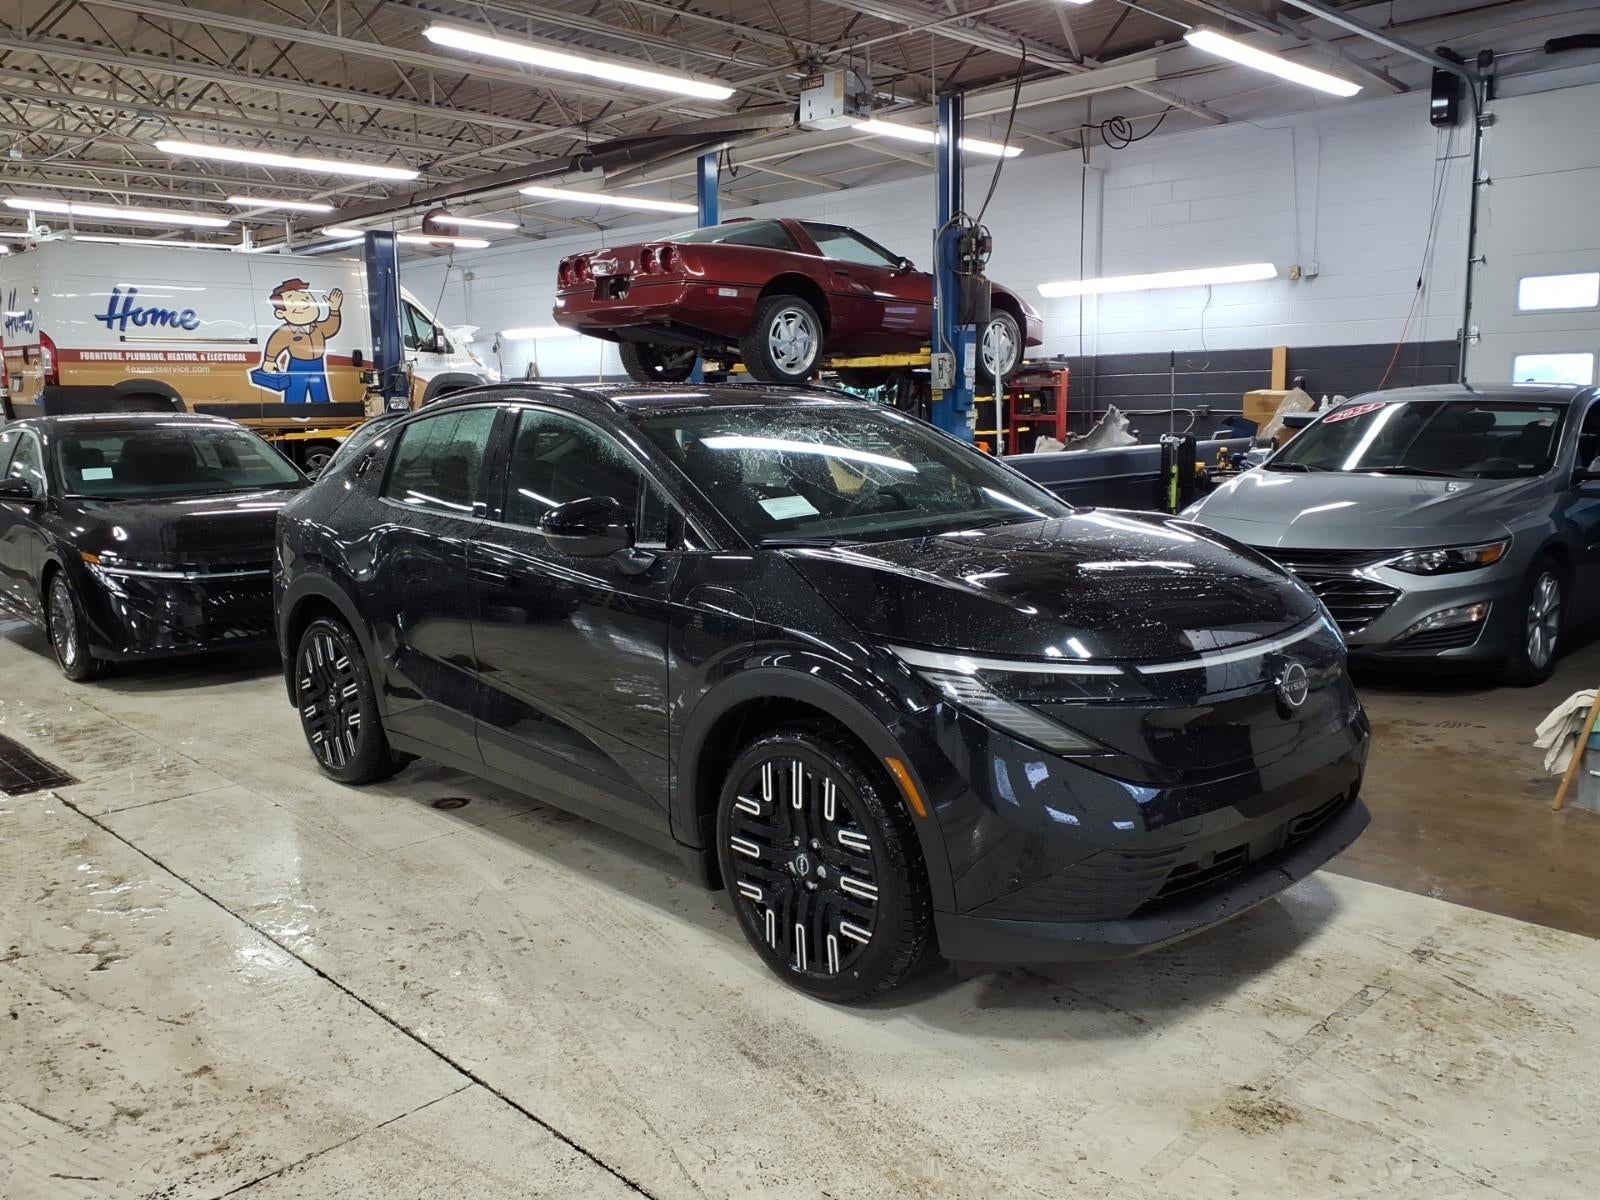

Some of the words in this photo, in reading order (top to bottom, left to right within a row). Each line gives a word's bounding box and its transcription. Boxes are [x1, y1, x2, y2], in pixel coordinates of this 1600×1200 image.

[94, 287, 201, 332] Home
[80, 351, 125, 361] FURNITURE,
[126, 351, 166, 362] PLUMBING,
[167, 351, 199, 362] HEATING,
[207, 351, 247, 362] ELECTRICAL
[125, 364, 211, 374] 4expertservice.com
